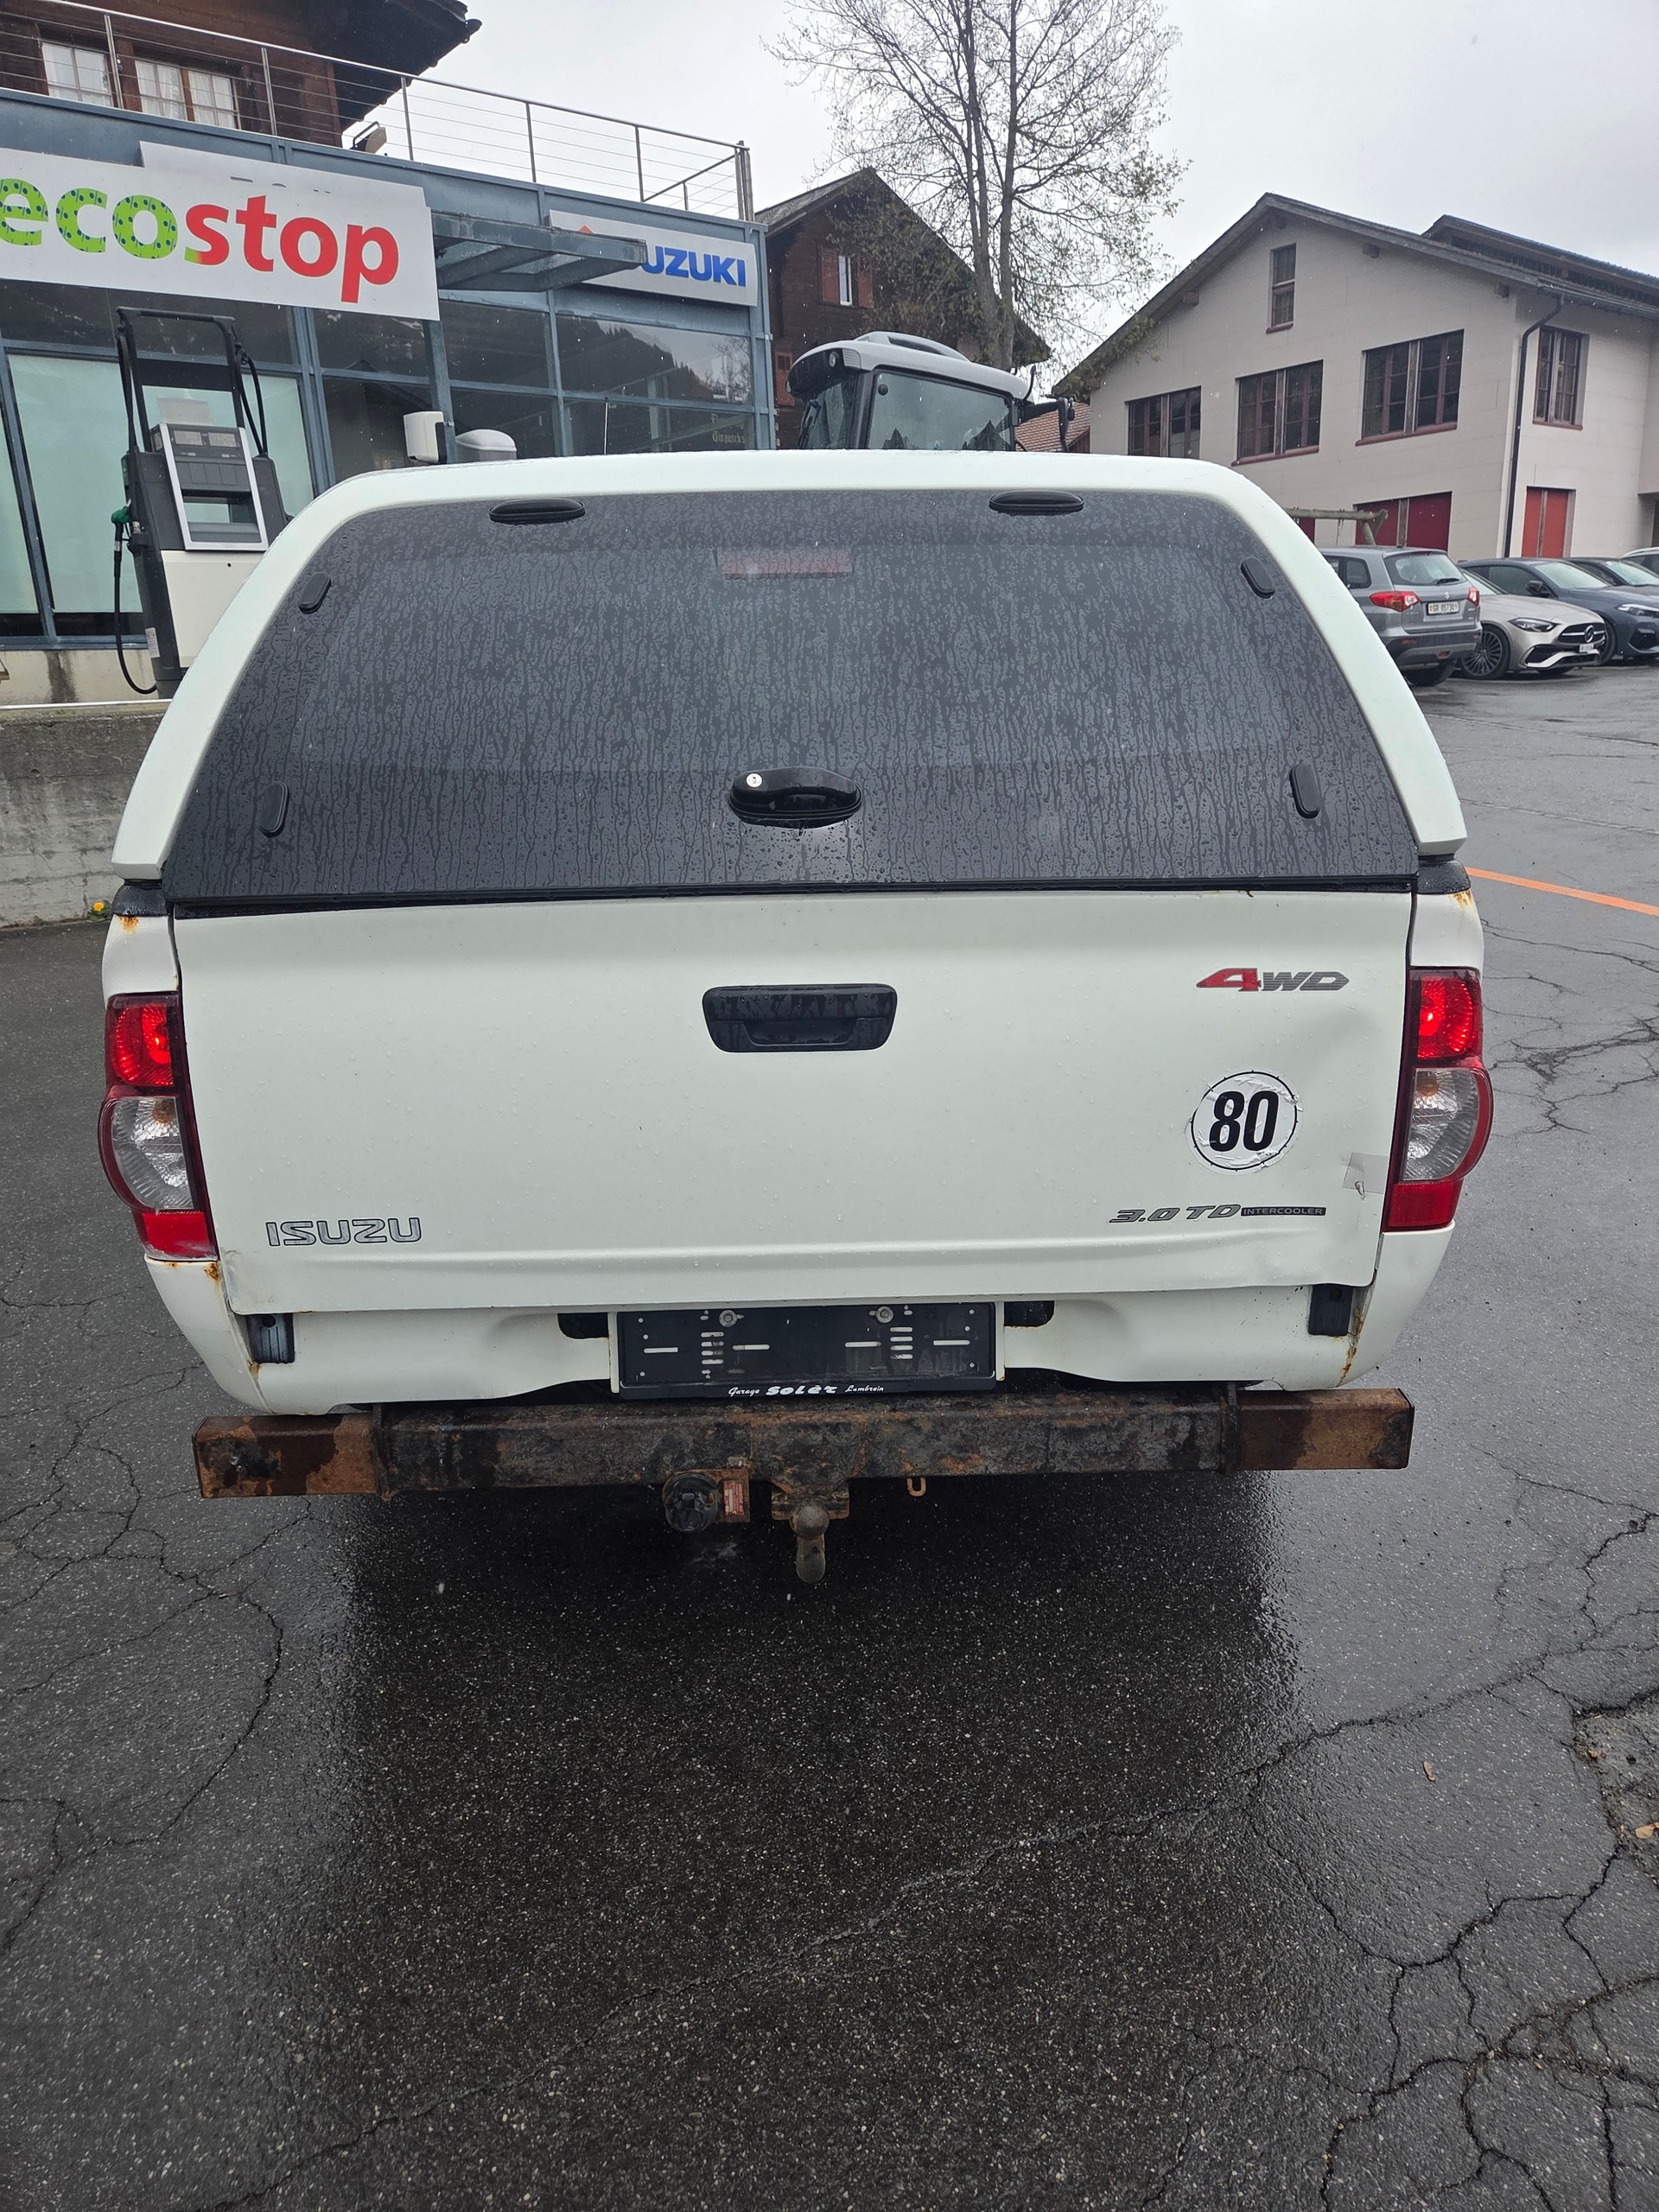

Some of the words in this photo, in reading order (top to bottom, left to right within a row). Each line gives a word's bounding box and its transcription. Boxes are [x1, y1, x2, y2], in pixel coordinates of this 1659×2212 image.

[0, 178, 399, 304] ecostop
[641, 245, 747, 288] UZUKI
[1197, 968, 1350, 992] 4WD
[1209, 1090, 1280, 1152] 80
[1109, 1209, 1180, 1224] 3.0
[1185, 1204, 1242, 1219] TD
[1243, 1206, 1325, 1216] INTERCOOLER
[265, 1217, 422, 1246] ISUZU
[728, 1387, 760, 1397] Garage
[845, 1384, 885, 1393] Lumbrein
